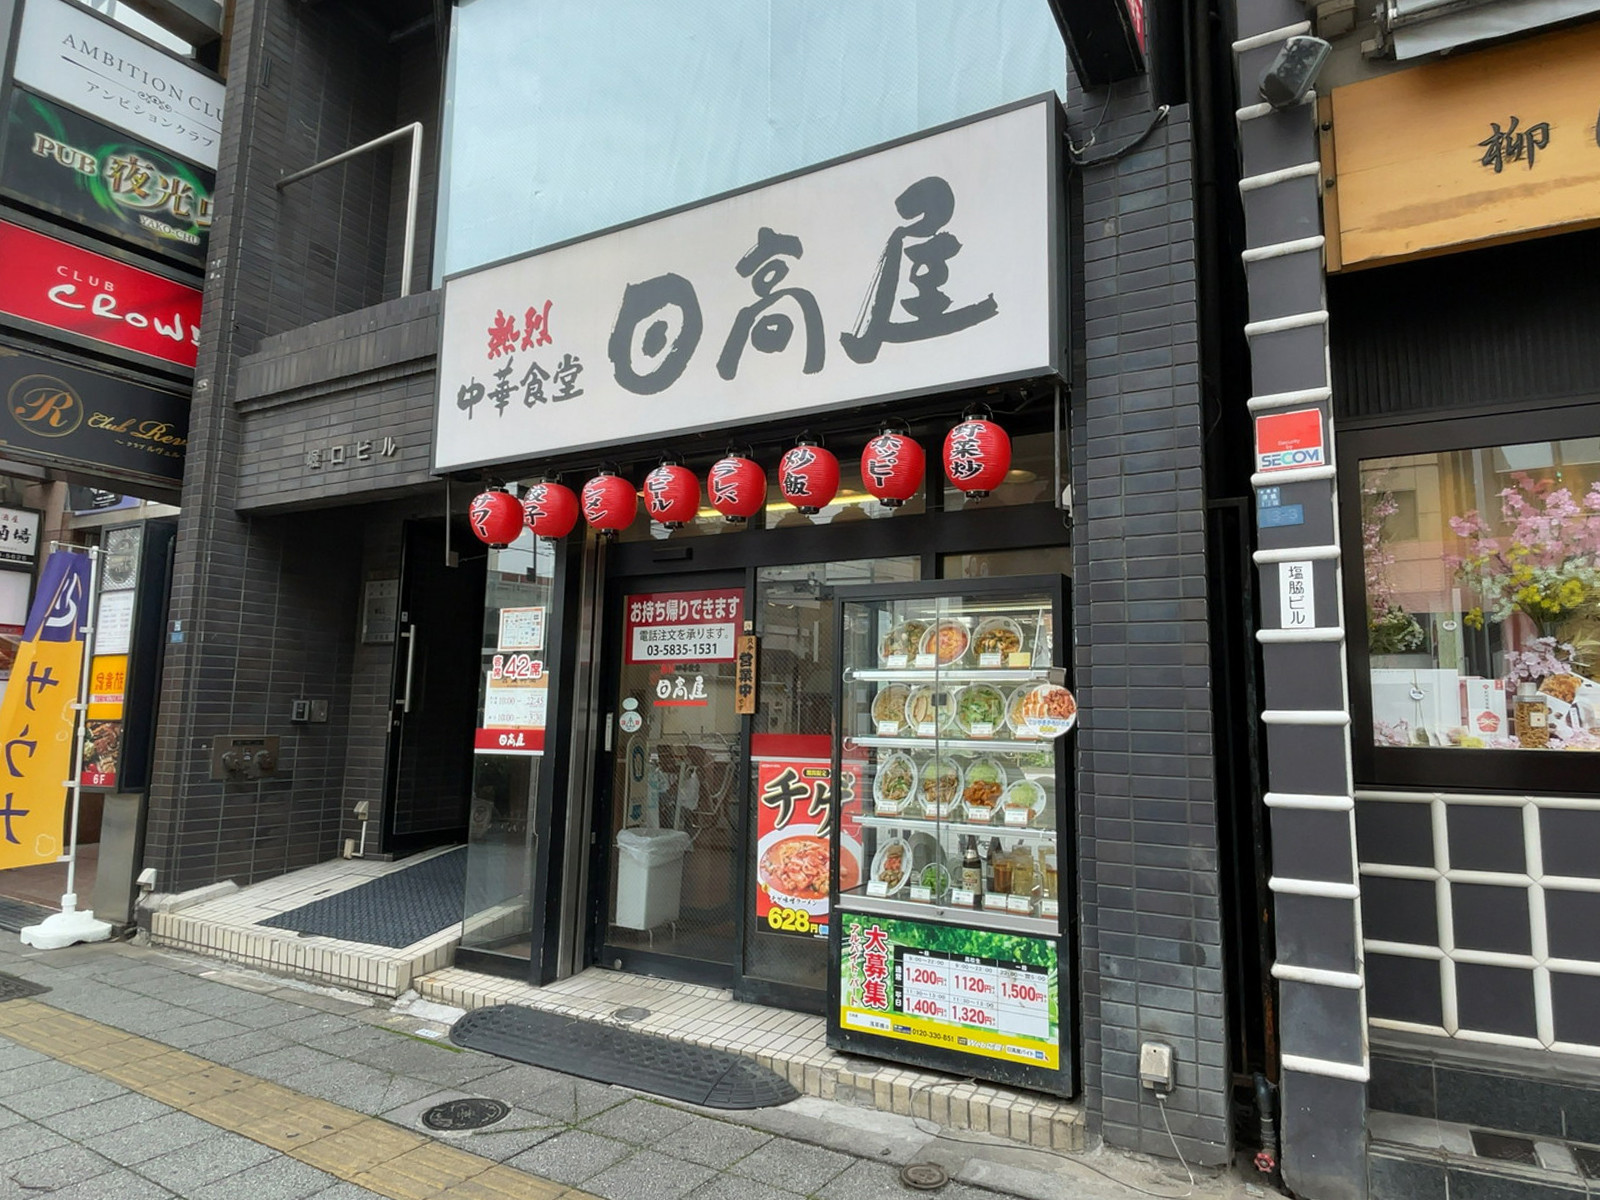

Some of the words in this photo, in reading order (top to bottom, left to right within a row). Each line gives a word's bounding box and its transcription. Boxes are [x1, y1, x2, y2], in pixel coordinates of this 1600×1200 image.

[62, 33, 184, 102] AMBITION
[33, 133, 97, 175] PUB
[1477, 116, 1550, 173] 柳
[140, 214, 200, 245] YAKO-CHU
[57, 265, 115, 293] CLUB
[607, 176, 999, 396] 日高屋
[487, 300, 553, 360] 熱烈
[457, 355, 584, 421] 中華食堂
[87, 411, 137, 433] Club
[868, 436, 902, 487] ホッピー
[950, 423, 985, 478] 野菜炒
[1261, 448, 1320, 468] SECOM
[782, 448, 816, 496] 炒飯
[471, 494, 494, 537] サワー
[524, 485, 547, 527] 餃子
[629, 595, 740, 623] お持ち帰りできます
[1288, 565, 1306, 624] 塩脇ビル
[639, 626, 729, 642] 電話注文を承ります。
[646, 643, 718, 657] 03-5835-1531
[656, 674, 708, 700] 日高屋
[738, 651, 754, 698] 営業中
[498, 732, 526, 747] 日高屋
[92, 773, 106, 785] 6F
[863, 923, 888, 1008] 大募集
[906, 967, 943, 986] 1,200円
[906, 997, 943, 1016] 1,400円
[1001, 982, 1044, 1003] 1,500円
[952, 1005, 993, 1026] 1,320円
[912, 1028, 955, 1043] 0120-330-851
